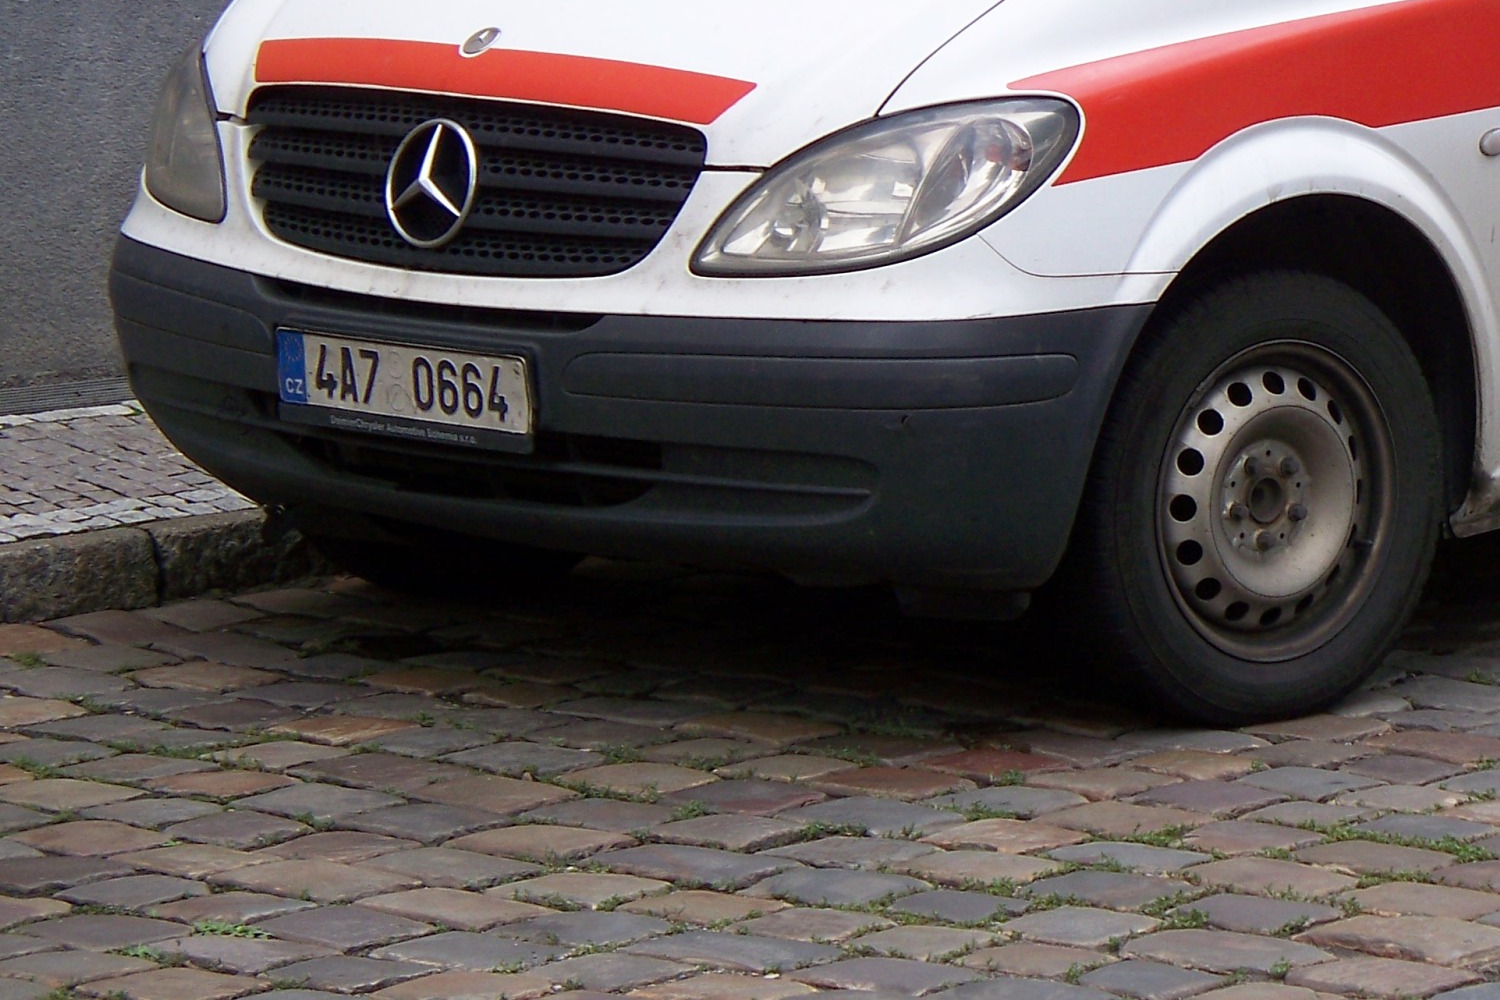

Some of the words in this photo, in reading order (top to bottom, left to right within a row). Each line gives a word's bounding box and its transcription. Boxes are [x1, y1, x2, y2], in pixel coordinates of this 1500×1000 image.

[285, 378, 303, 395] CZ
[315, 344, 380, 404] 4A7
[412, 356, 508, 422] 0664
